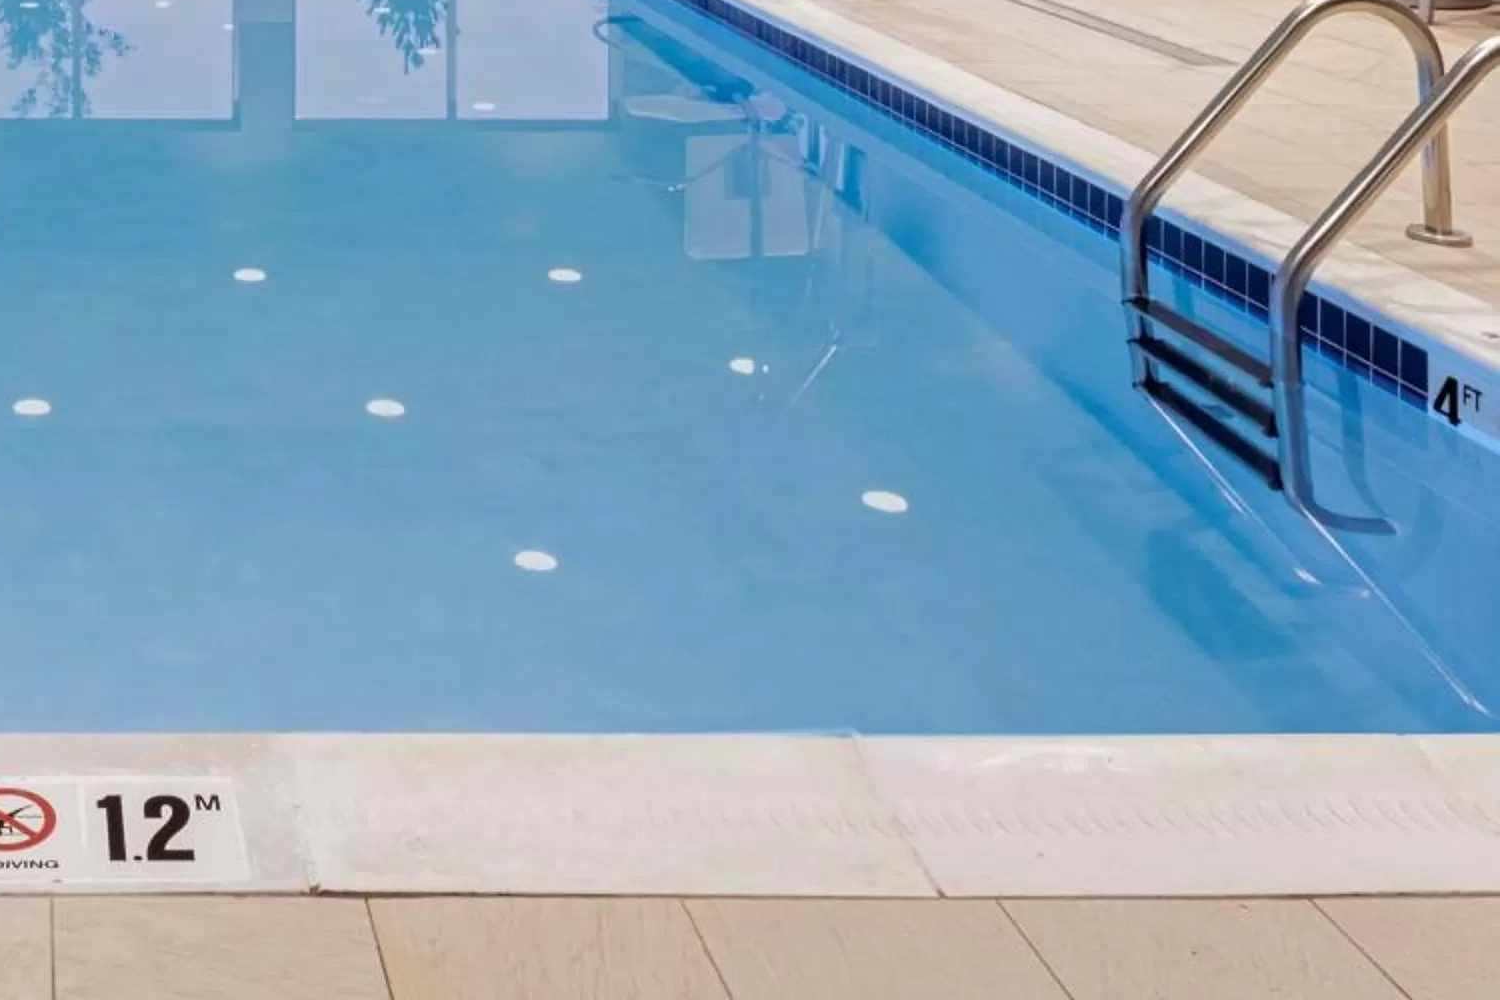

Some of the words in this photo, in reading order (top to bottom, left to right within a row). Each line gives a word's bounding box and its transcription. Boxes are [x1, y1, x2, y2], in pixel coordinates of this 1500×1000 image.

[1433, 375, 1462, 428] 4
[1462, 383, 1483, 413] FT
[96, 794, 195, 862] 1.2
[194, 794, 221, 811] M
